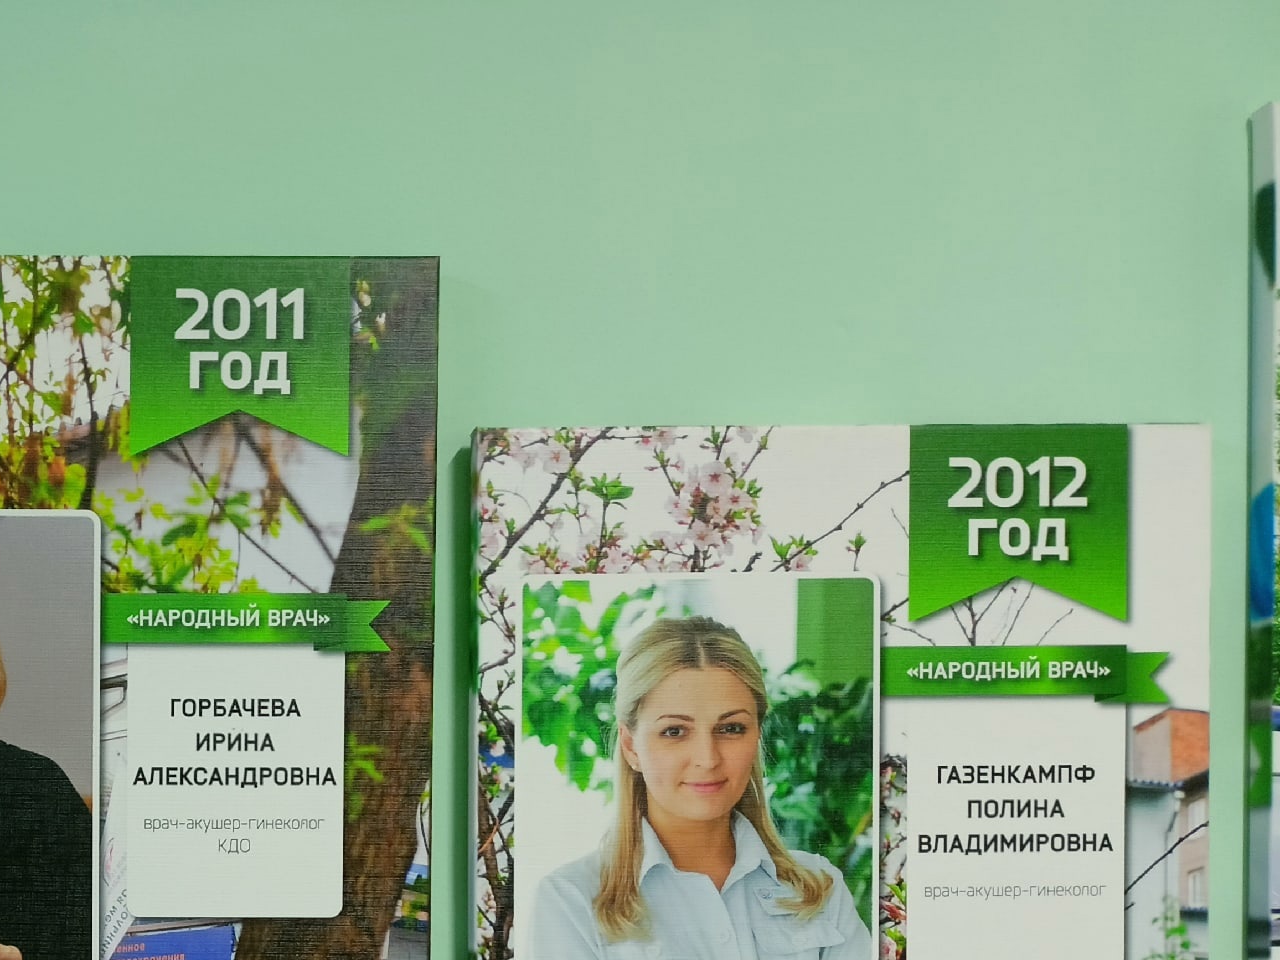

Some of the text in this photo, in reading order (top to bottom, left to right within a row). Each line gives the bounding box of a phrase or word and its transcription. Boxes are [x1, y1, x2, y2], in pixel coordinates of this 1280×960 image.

[174, 288, 304, 340] 2011
[947, 456, 1088, 508] 2012
[127, 604, 330, 628] «НАРОДНЫЙ ВРАЧ»
[906, 656, 1111, 680] «НАРОДНЫЙ ВРАЧ»
[170, 699, 301, 717] ГОРБАЧЕВА
[196, 733, 275, 751] ИРИНА
[133, 767, 337, 788] АЛЕКСАНДРОВНА
[937, 765, 1095, 784] ГАЗЕНКАМПФ
[968, 799, 1065, 819] ПОЛИНА
[144, 818, 325, 832] врач-акушер-гинеколог
[218, 839, 251, 854] КДО
[918, 833, 1113, 855] ВЛАДИМИРОВНА
[924, 885, 1106, 901] врач-акушер-гинеколог
